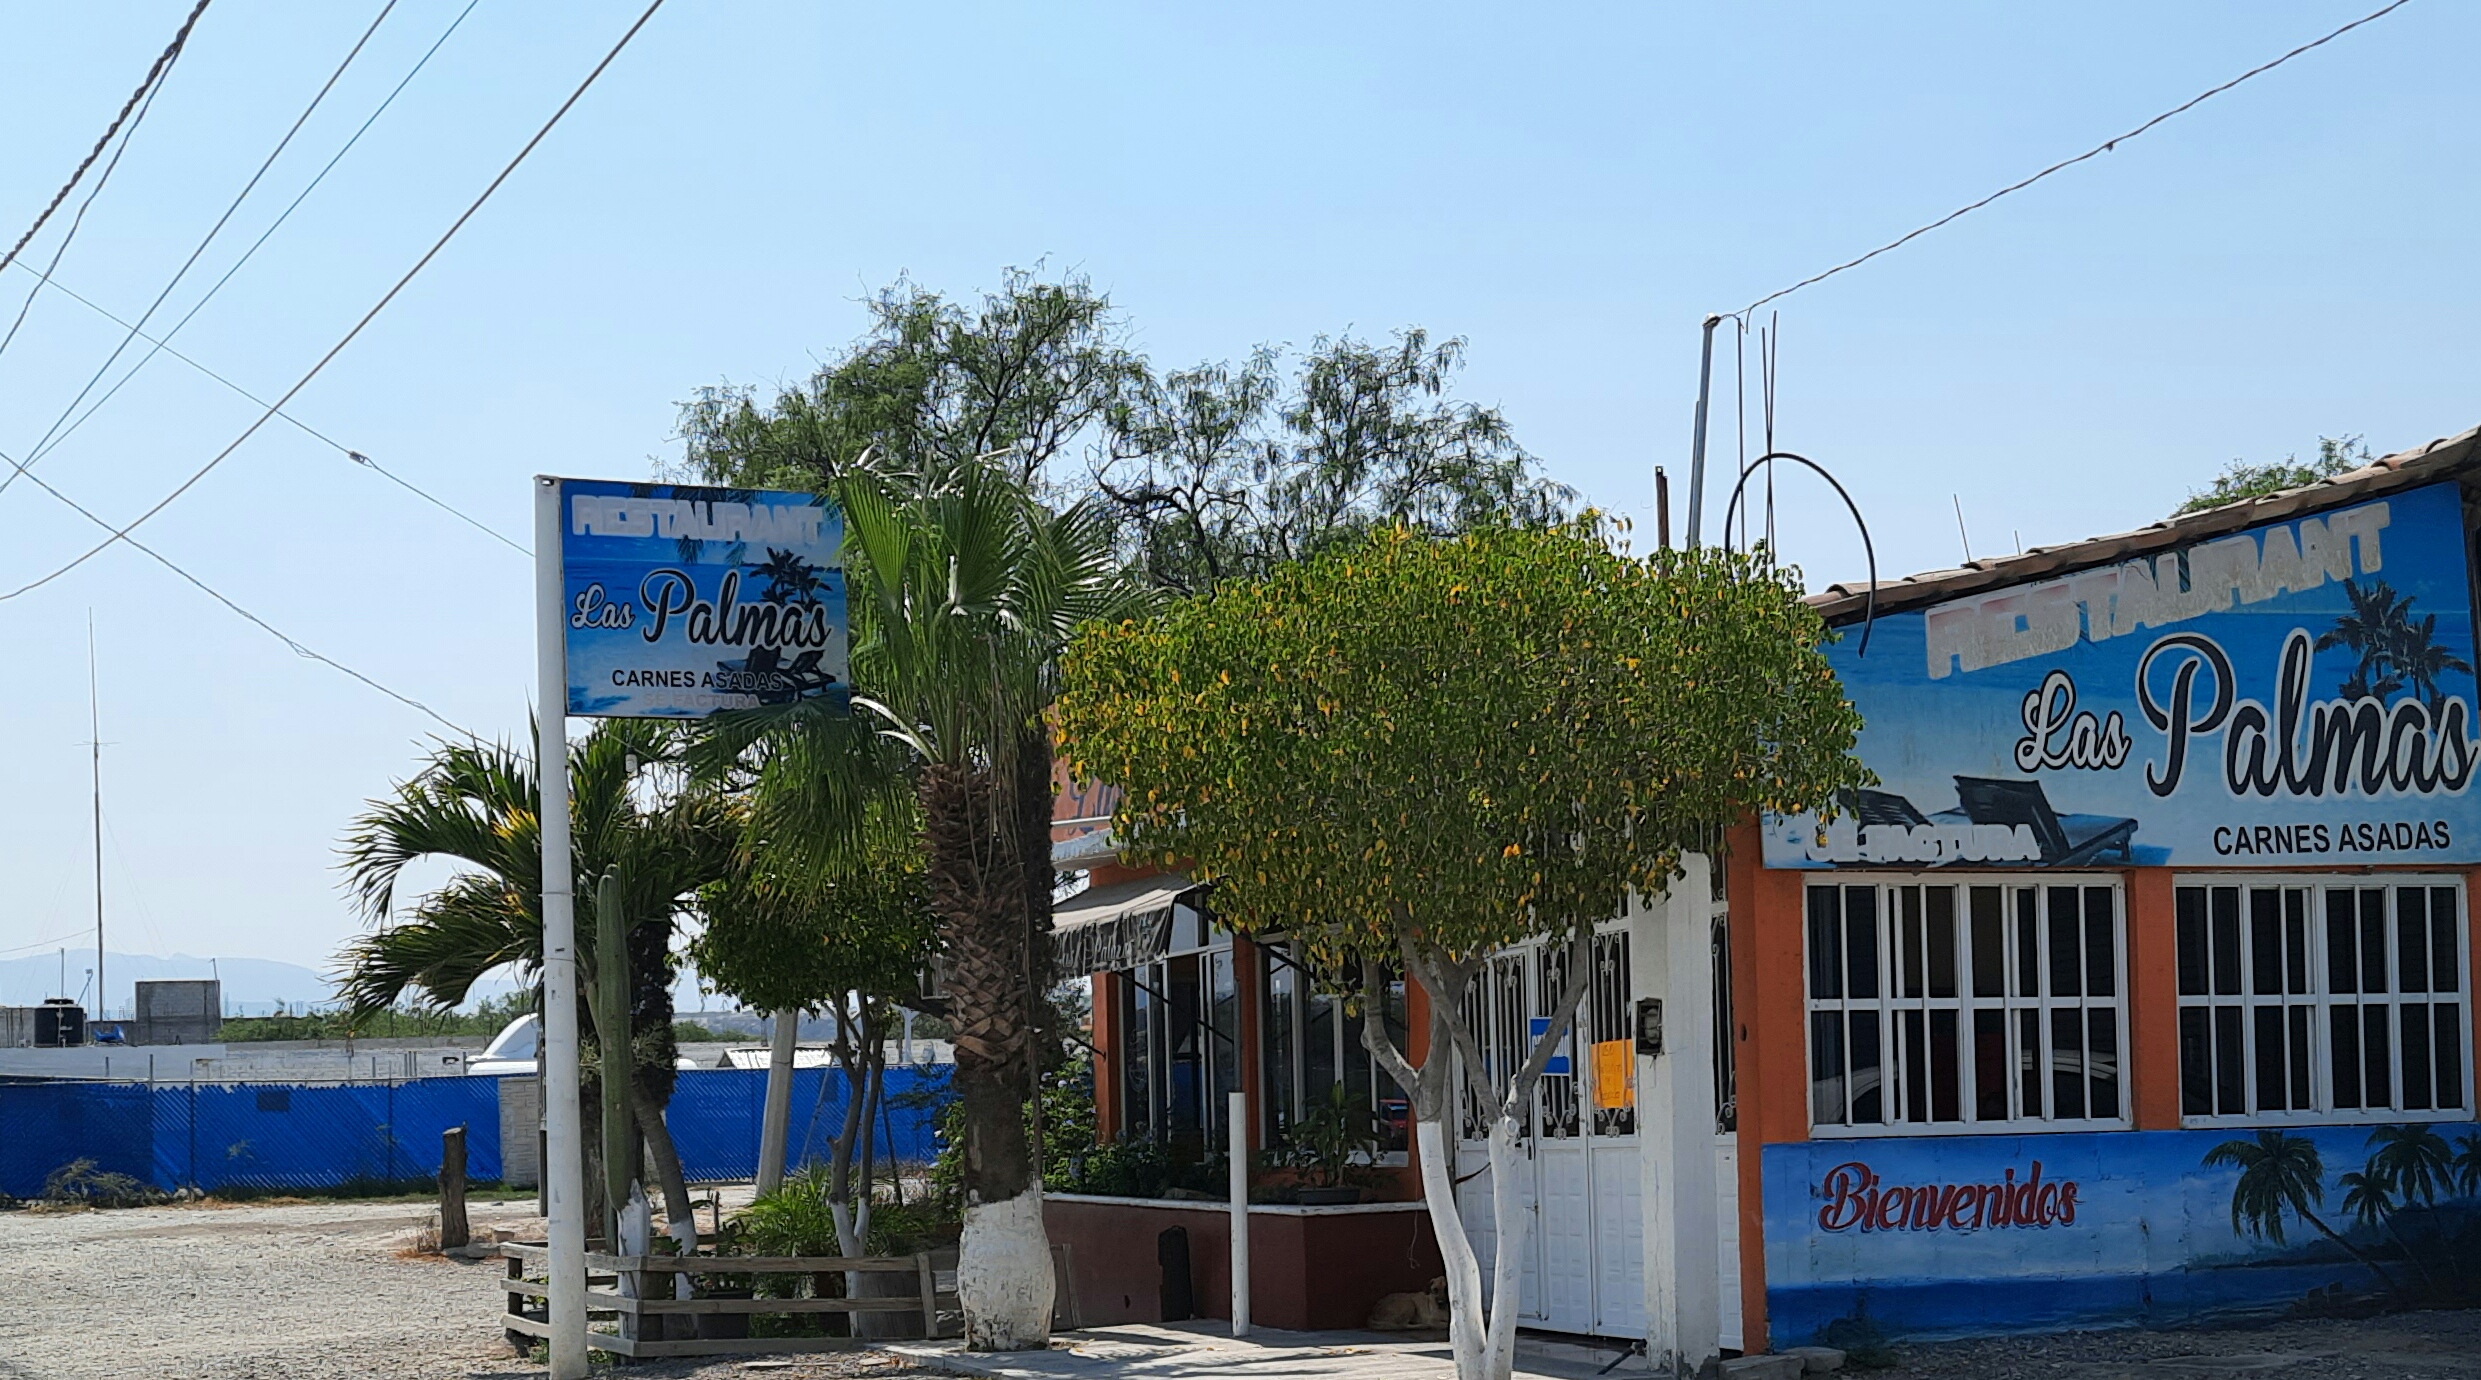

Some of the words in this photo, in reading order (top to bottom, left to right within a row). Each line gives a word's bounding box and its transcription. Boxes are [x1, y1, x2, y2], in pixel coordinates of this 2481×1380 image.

[571, 494, 824, 543] RESTAURANT
[571, 583, 637, 630] Las
[639, 568, 834, 649] Palmas
[1925, 501, 2391, 680] RESTAURANT
[612, 669, 696, 688] CARNES
[701, 671, 783, 691] ASADAS
[672, 693, 761, 709] FACTURA
[2014, 669, 2132, 774] Las
[2136, 627, 2481, 800] Palmas
[2213, 826, 2332, 855] CARNES
[2338, 820, 2451, 852] ASADAS
[1817, 1160, 2078, 1234] Bienvenidos
